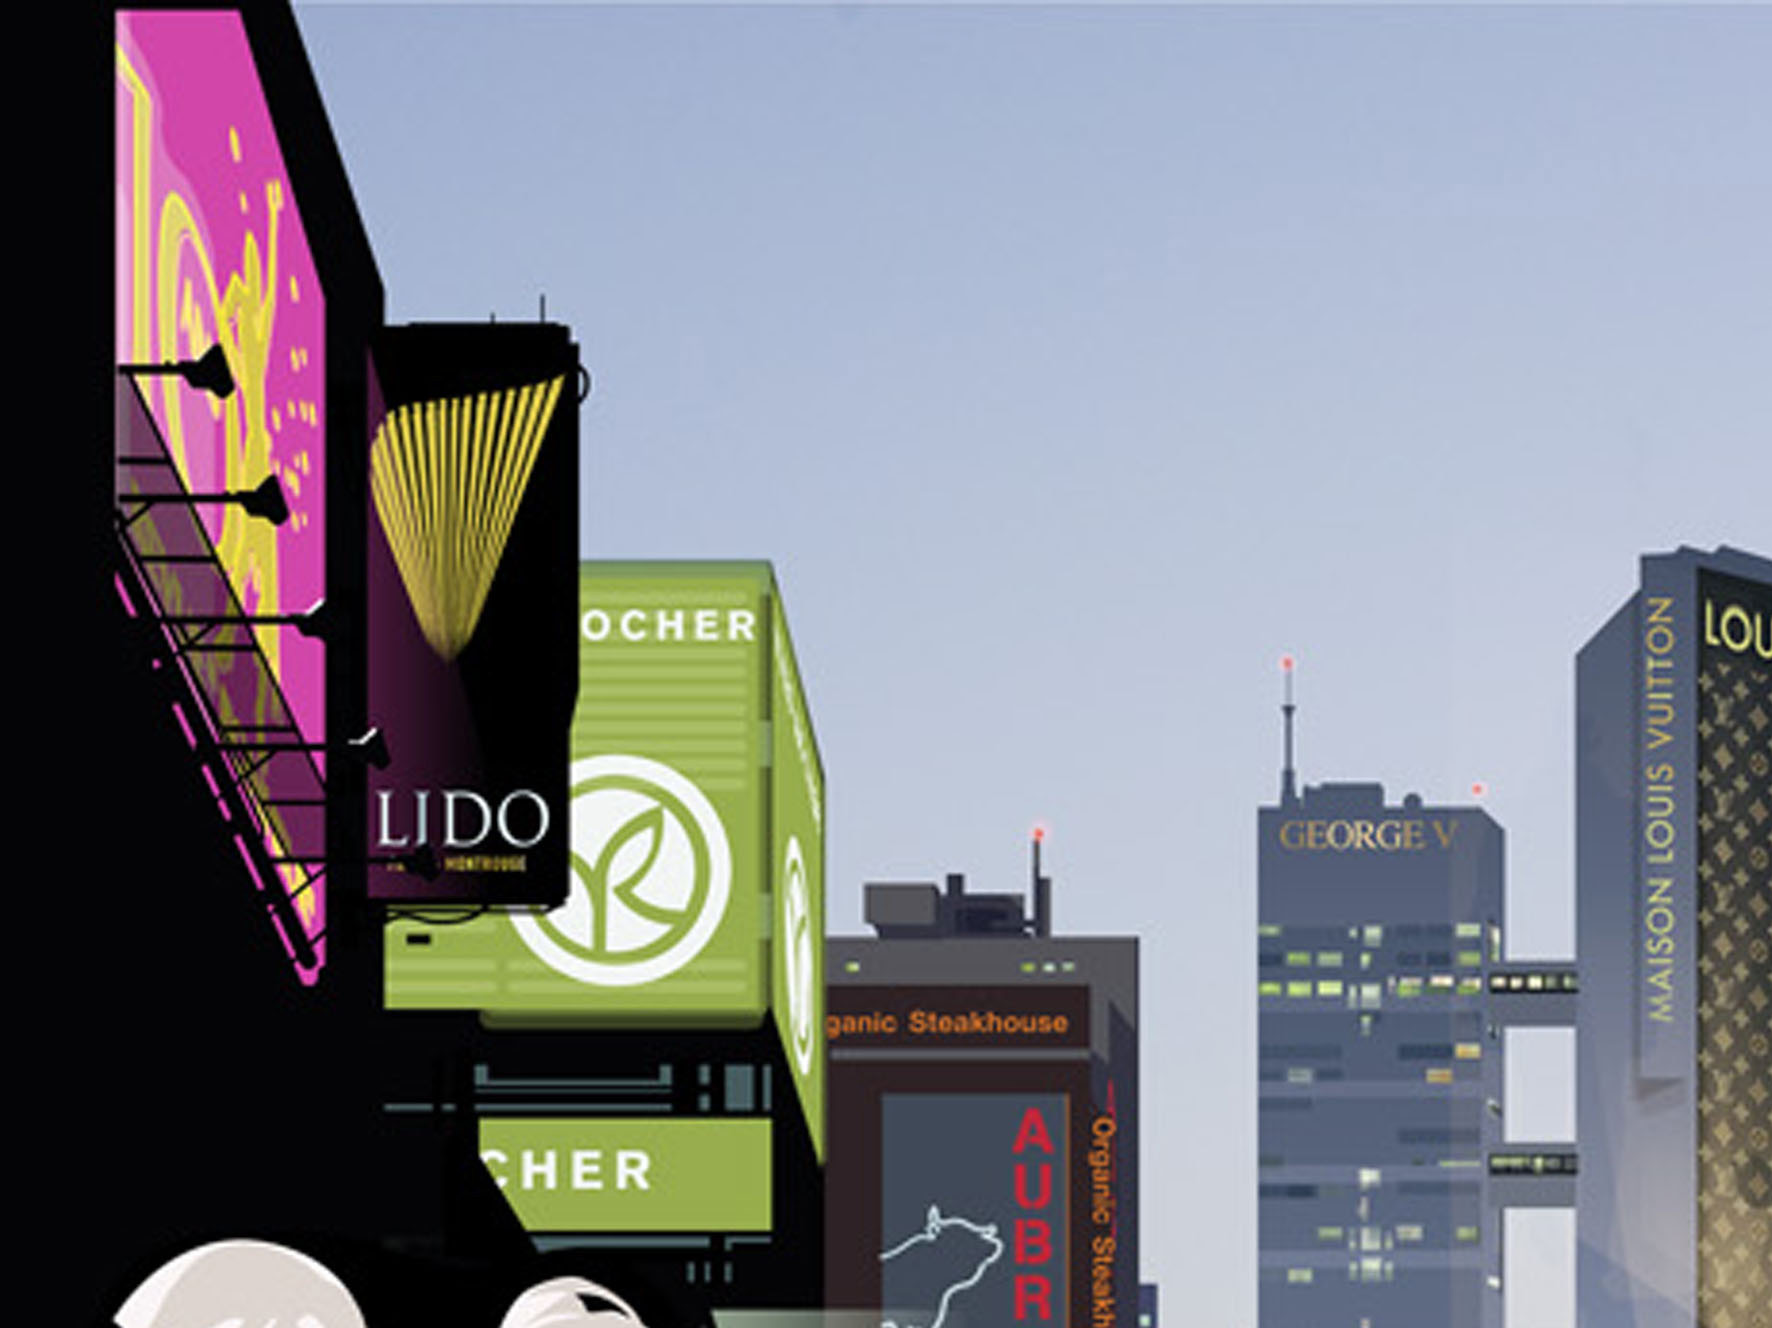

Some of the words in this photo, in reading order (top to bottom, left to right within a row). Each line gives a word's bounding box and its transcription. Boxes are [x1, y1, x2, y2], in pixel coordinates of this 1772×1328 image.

[582, 610, 757, 643] OCHER
[1646, 597, 1675, 751] VUITTON
[376, 789, 549, 848] LIDO
[1280, 819, 1427, 851] GEORGE
[1433, 819, 1460, 849] V
[1646, 764, 1675, 865] LOUIS
[1646, 878, 1675, 1023] MAISON
[908, 1009, 1069, 1035] Steakhouse
[1088, 1118, 1118, 1223] Organic
